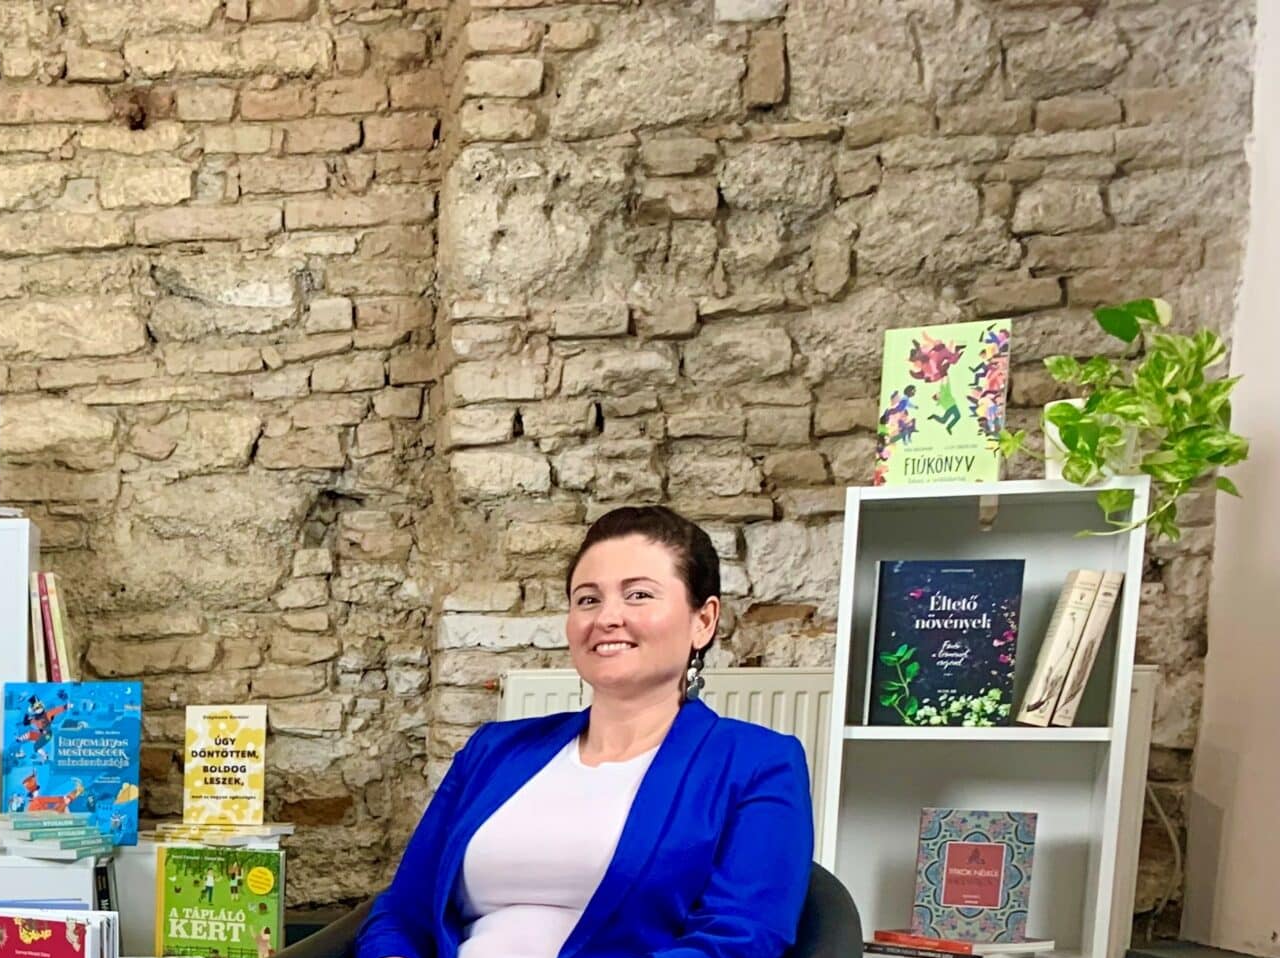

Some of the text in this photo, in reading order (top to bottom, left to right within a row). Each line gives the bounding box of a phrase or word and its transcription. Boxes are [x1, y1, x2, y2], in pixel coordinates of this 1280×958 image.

[904, 455, 976, 476] FIÚKÖNYV
[929, 590, 980, 611] Éltető
[915, 613, 991, 634] növények
[214, 735, 236, 746] ÚGY
[191, 749, 259, 759] DÖNTÖTTEM,
[202, 765, 247, 773] BOLDOG
[203, 777, 244, 786] LESZEK,
[169, 907, 246, 922] A TÁPLÁLÓ
[169, 919, 245, 943] KERT
